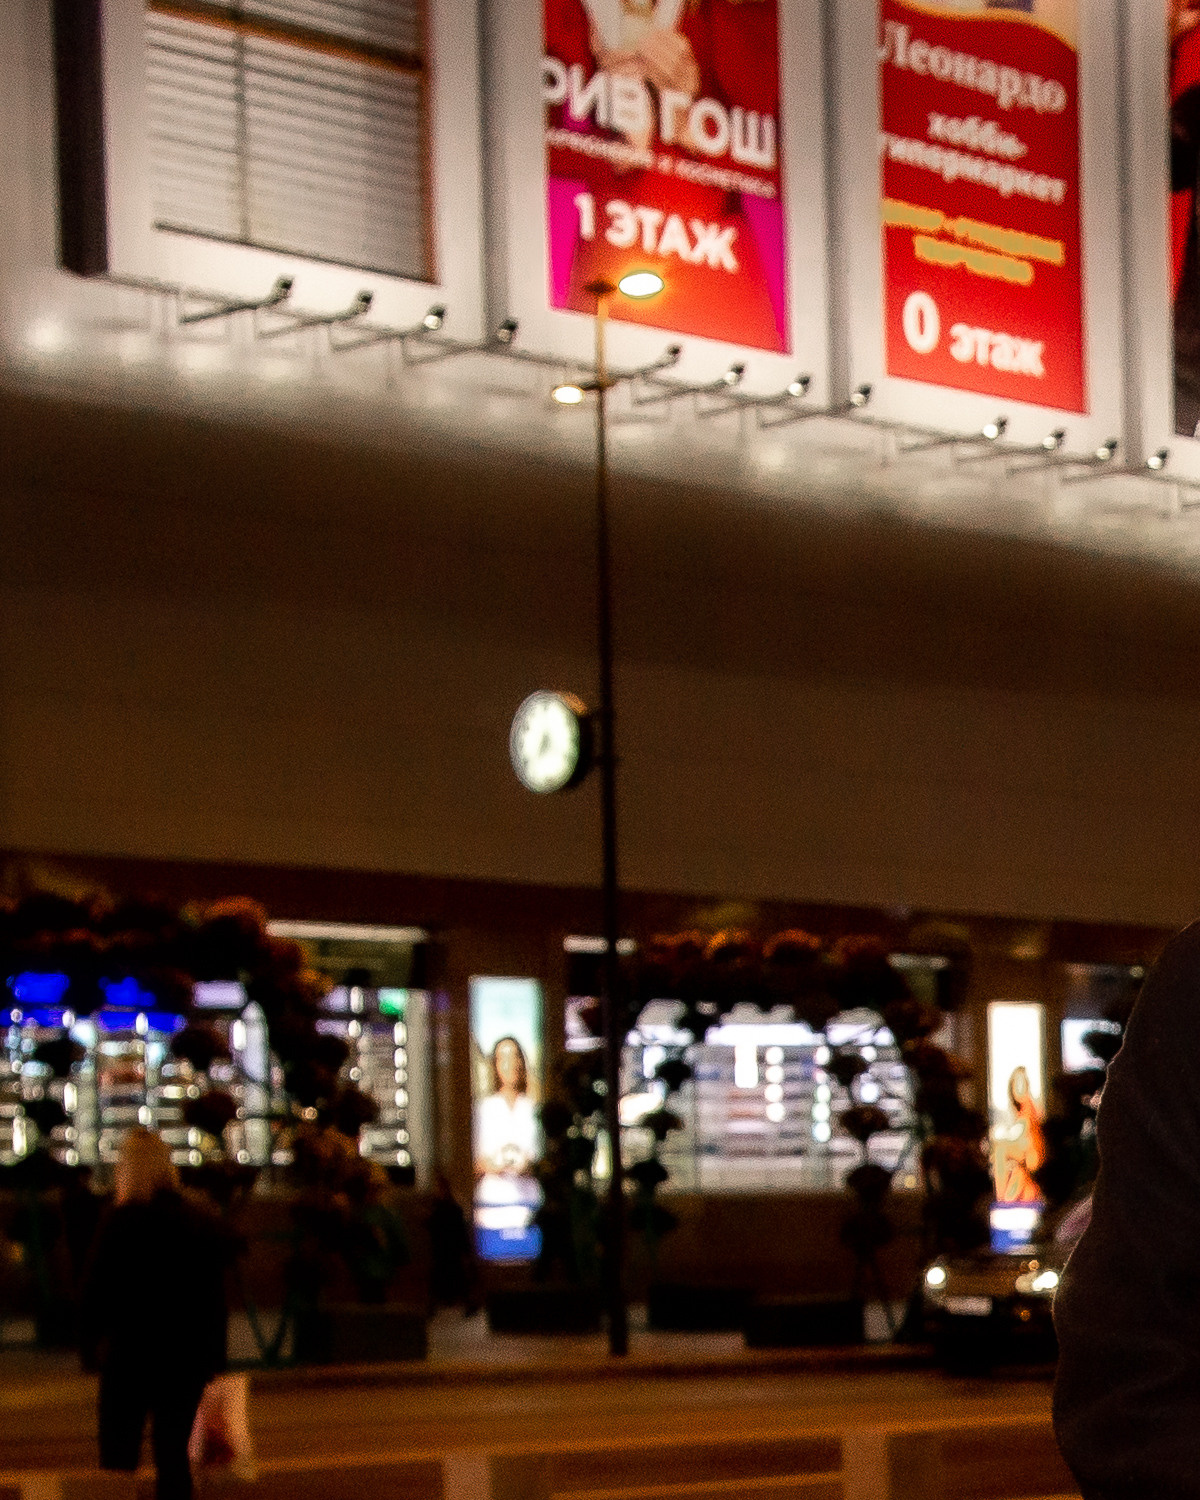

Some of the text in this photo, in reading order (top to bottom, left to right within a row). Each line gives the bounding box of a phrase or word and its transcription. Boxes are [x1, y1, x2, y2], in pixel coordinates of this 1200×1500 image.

[880, 20, 1067, 113] Леонардо
[660, 89, 777, 170] ГОШ
[574, 192, 739, 273] 1 ЭТАЖ
[903, 290, 1045, 378] 0 этаж
